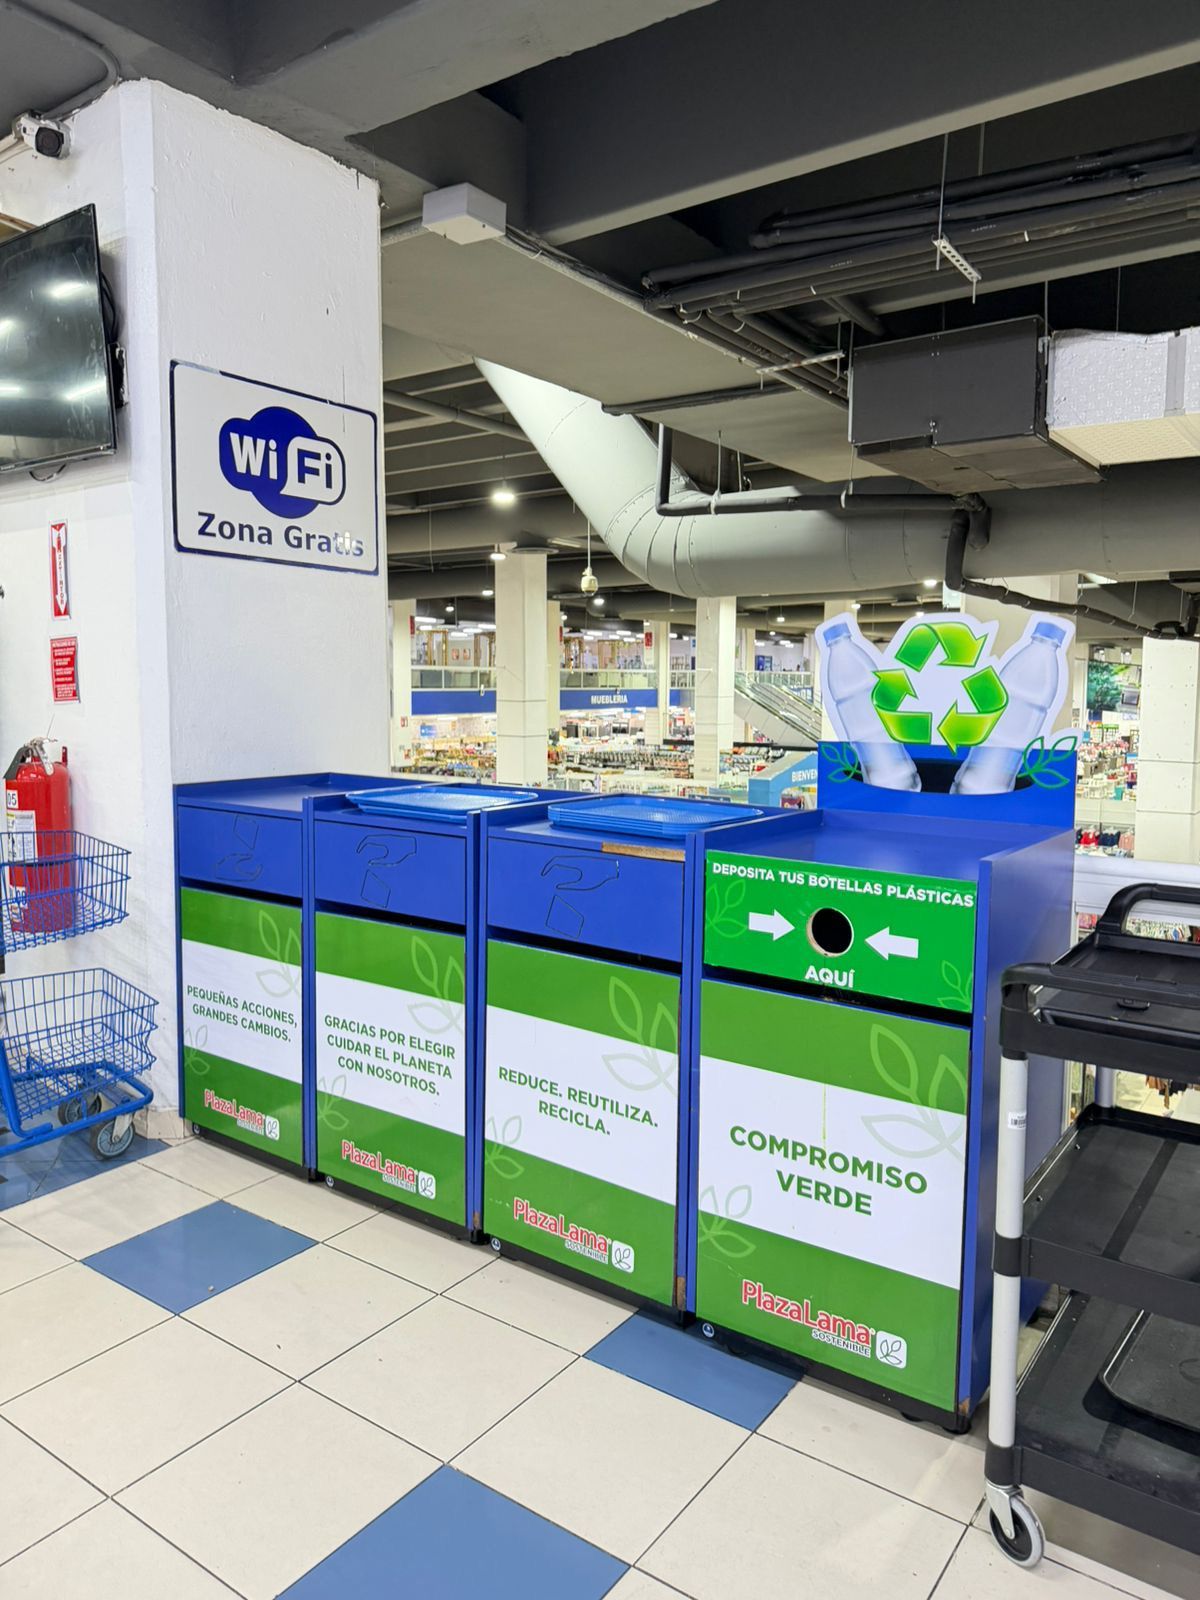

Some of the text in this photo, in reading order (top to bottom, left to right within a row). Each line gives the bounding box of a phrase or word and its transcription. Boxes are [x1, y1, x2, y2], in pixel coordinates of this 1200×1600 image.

[197, 511, 272, 545] Zona
[713, 862, 974, 907] DEPOSITA TUS BOTELLAS PLÁSTICAS
[804, 965, 856, 988] AQUÍ
[187, 984, 298, 1028] PEQUEÑAS ACCIONES,
[192, 1003, 292, 1042] GRANDES CAMBIOS.
[324, 1015, 456, 1060] GRACIAS POR ELEGIR
[327, 1034, 452, 1079] CUIDAR EL PLANETA
[337, 1055, 441, 1096] CON NOSOTROS.
[499, 1066, 659, 1128] REDUCE. REUTILIZA.
[538, 1100, 611, 1135] RECICLA.
[729, 1125, 928, 1195] COMPROMISO
[776, 1170, 873, 1216] VERDE
[811, 1329, 872, 1358] SOSTENIBLE
